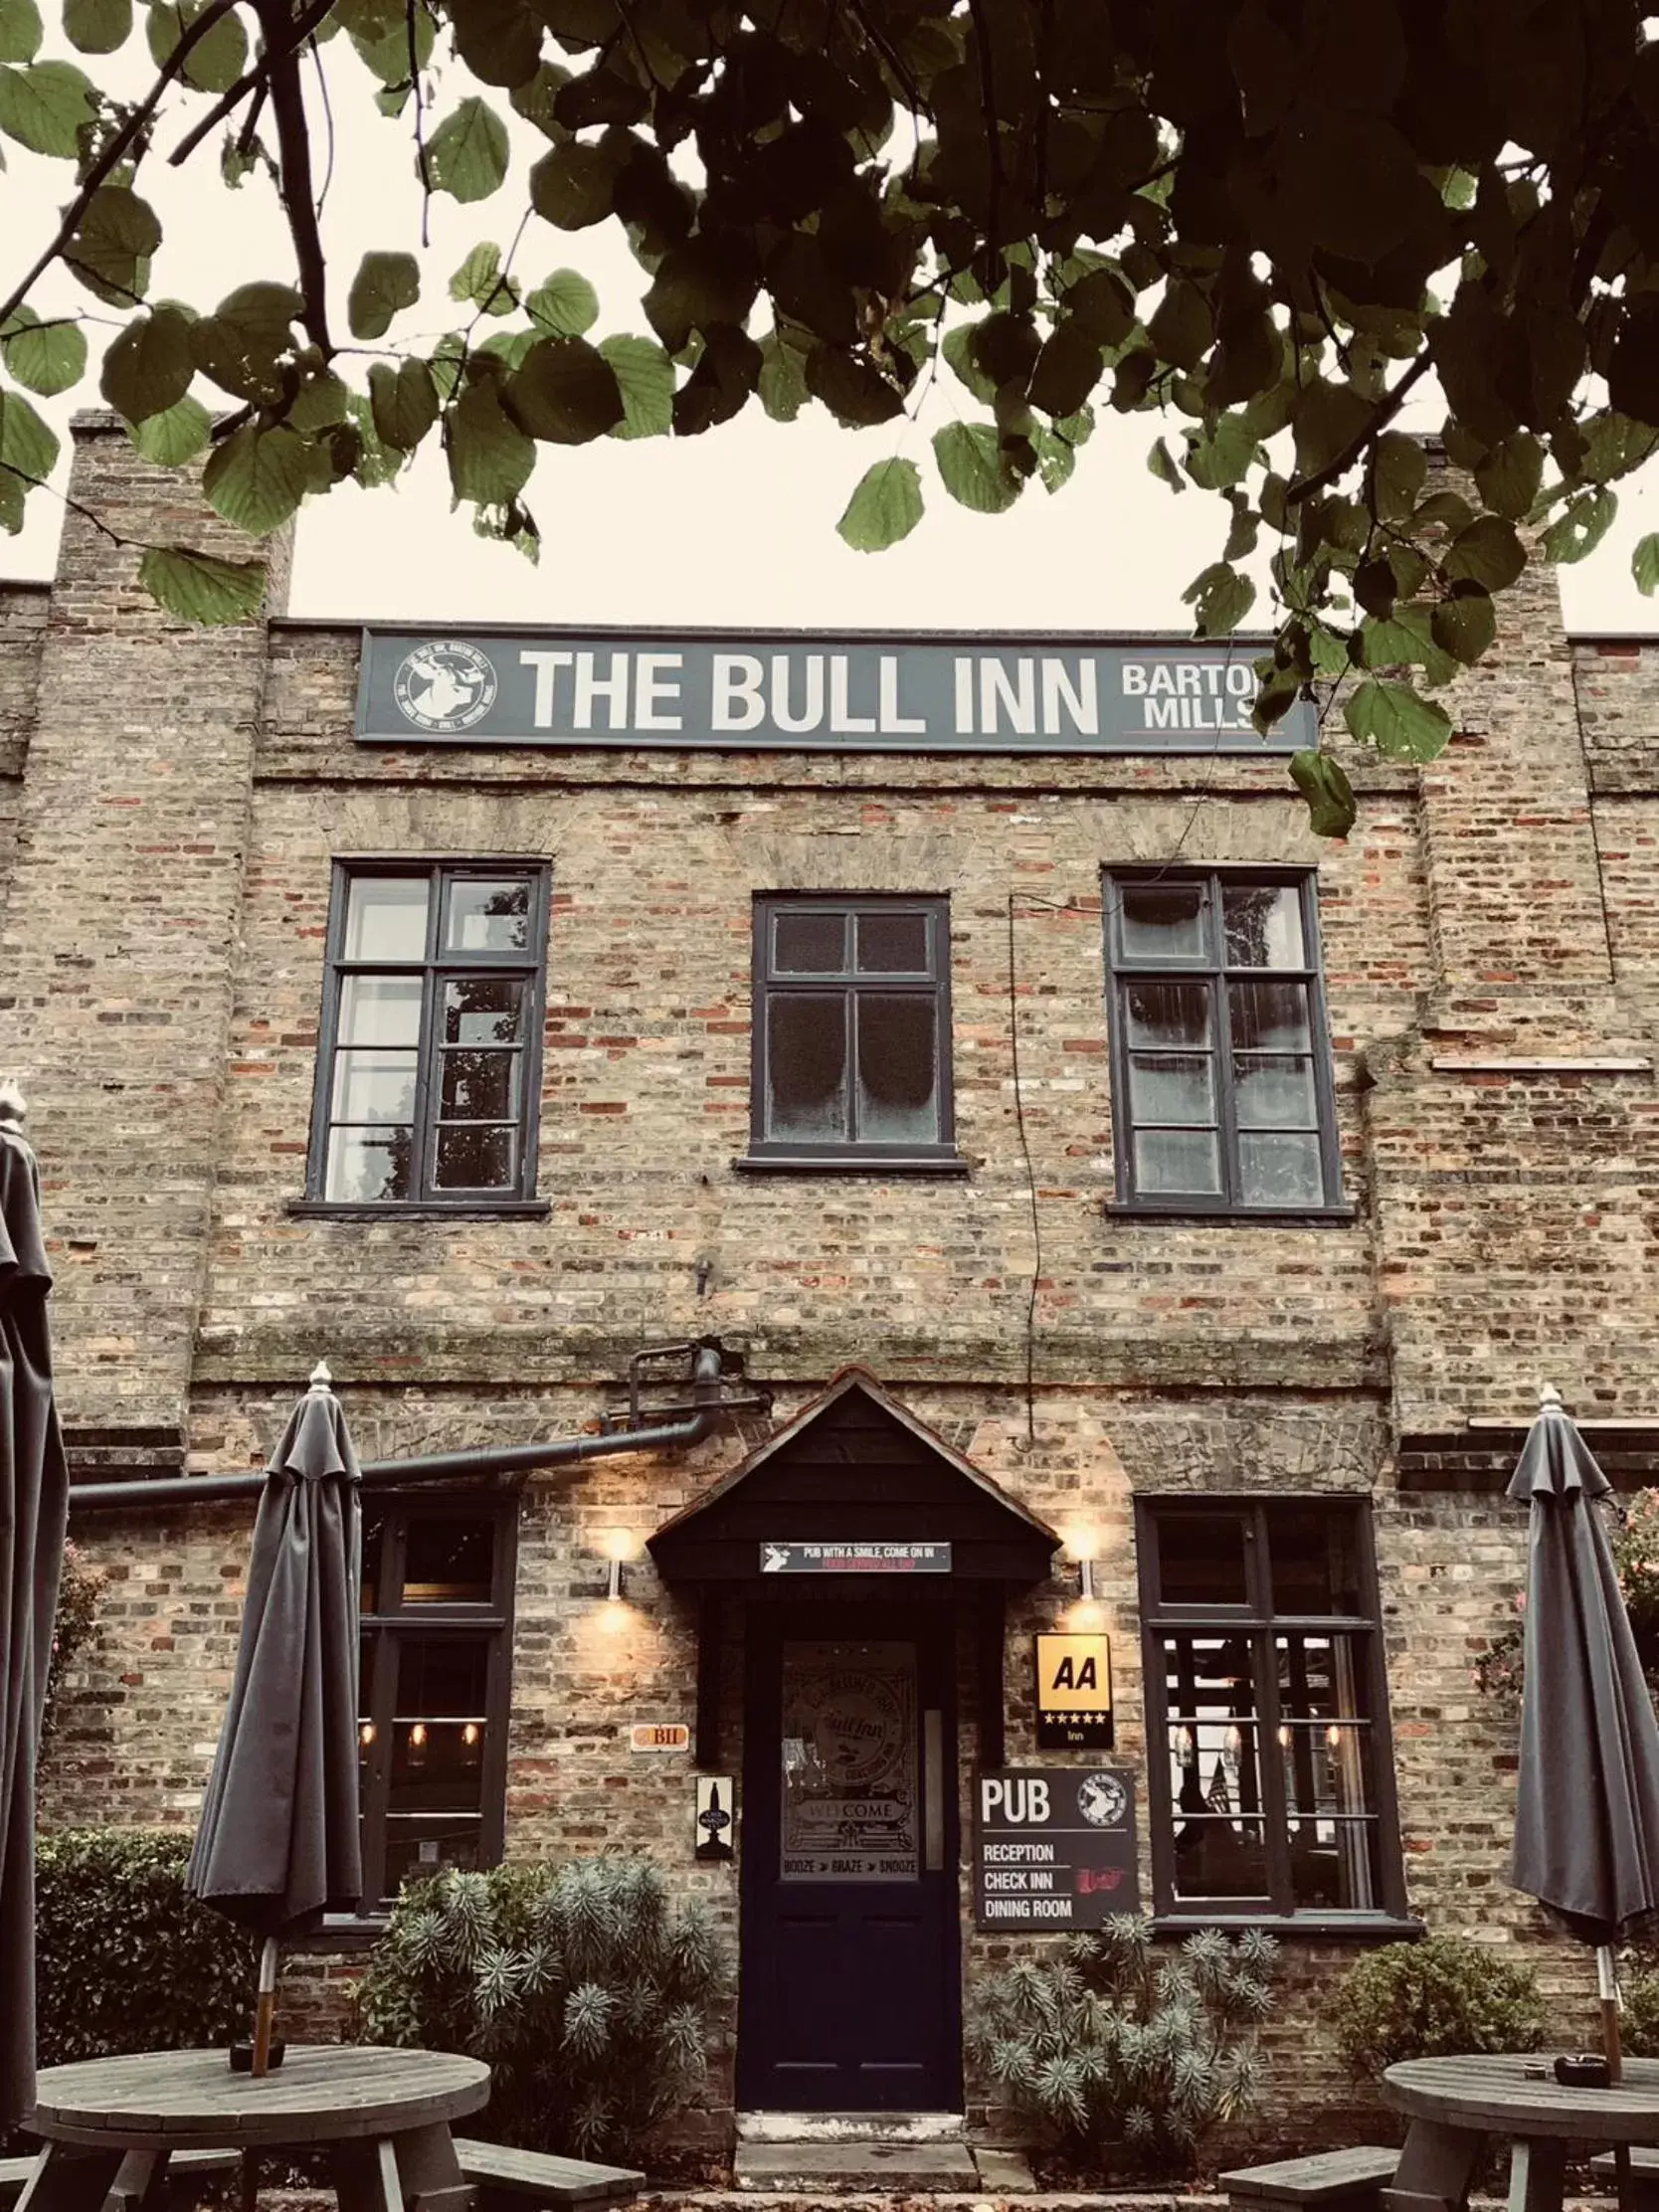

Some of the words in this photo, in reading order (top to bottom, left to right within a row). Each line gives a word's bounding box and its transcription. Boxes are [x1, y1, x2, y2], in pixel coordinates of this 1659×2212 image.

[1122, 663, 1258, 696] BARTO
[519, 650, 683, 731] THE
[711, 654, 927, 734] BULL
[955, 656, 1099, 735] INN
[804, 1547, 822, 1559] PUB
[823, 1547, 844, 1559] WITH
[845, 1547, 853, 1559] A
[853, 1547, 882, 1560] SMILE,
[884, 1547, 910, 1559] COME
[910, 1547, 924, 1559] ON
[925, 1547, 935, 1559] IN
[1052, 1656, 1097, 1691] AA
[1067, 1730, 1085, 1742] Inn
[981, 1778, 1051, 1823] PUB
[984, 1844, 1054, 1862] RECEPTION
[784, 1859, 815, 1874] BOOZE
[879, 1859, 916, 1874] SNOOZE
[985, 1872, 1027, 1890] CHECK
[1030, 1872, 1053, 1890] INN
[985, 1900, 1030, 1918] DINING
[1033, 1900, 1072, 1918] ROOM
